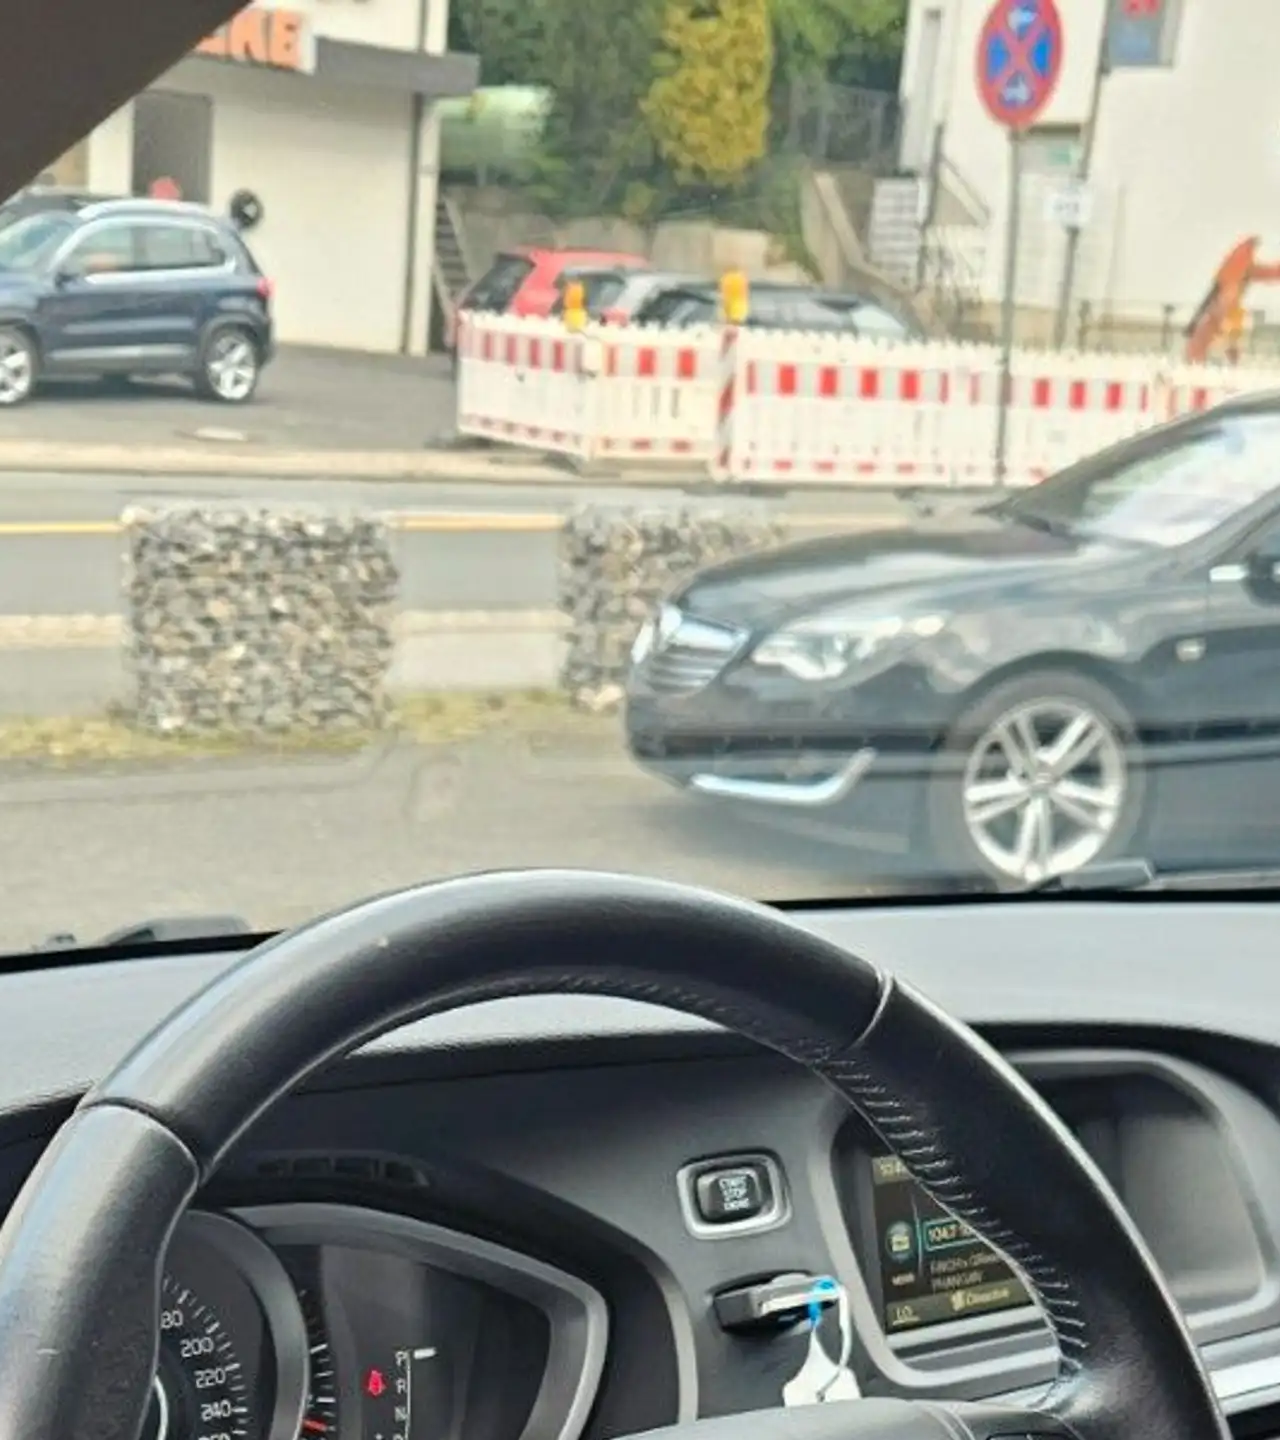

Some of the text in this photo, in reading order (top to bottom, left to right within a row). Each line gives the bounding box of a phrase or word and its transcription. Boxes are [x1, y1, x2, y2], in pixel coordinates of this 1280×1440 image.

[195, 7, 302, 70] KE
[180, 1337, 214, 1357] 200
[194, 1367, 226, 1388] 220
[395, 1378, 406, 1394] R
[201, 1399, 231, 1421] 240
[394, 1406, 407, 1422] N
